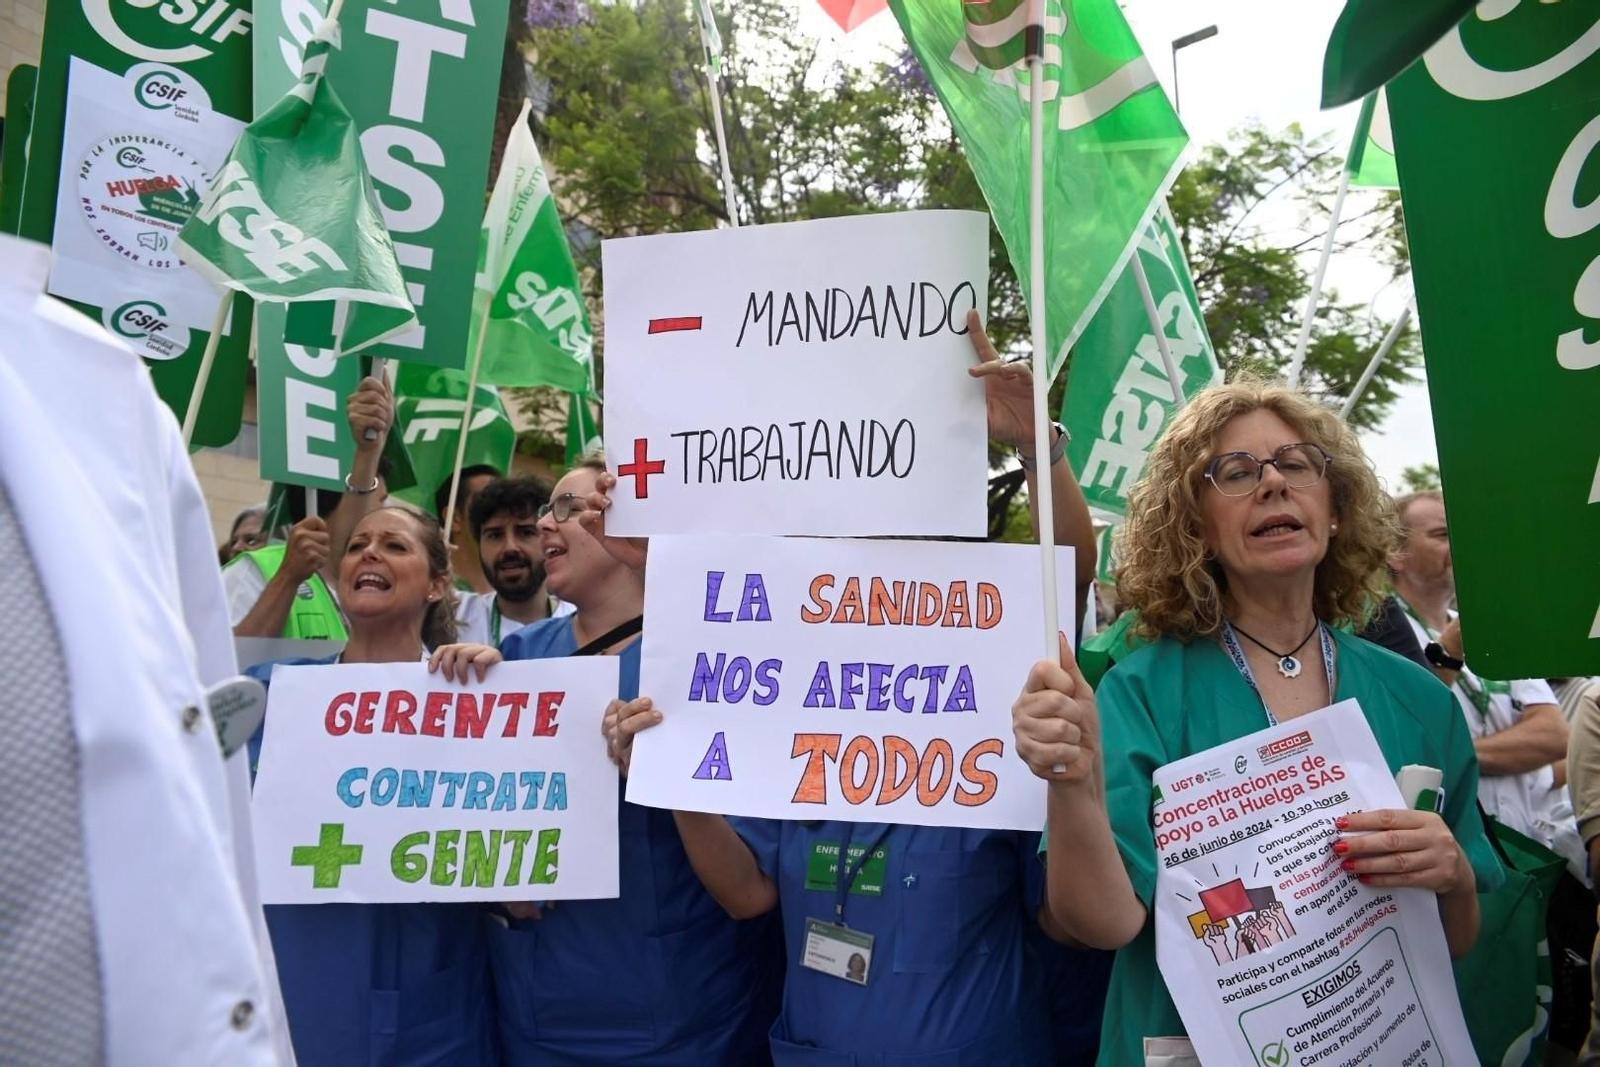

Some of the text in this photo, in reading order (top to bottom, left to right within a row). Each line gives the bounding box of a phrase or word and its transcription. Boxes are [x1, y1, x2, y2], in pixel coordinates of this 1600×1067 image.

[125, 0, 253, 43] SIF
[145, 81, 187, 102] CSIF
[122, 151, 146, 165] CSIF
[106, 174, 182, 198] HUELGA
[123, 309, 170, 333] CSIF
[735, 281, 977, 348] MANDANDO
[670, 418, 916, 484] TRABAJANDO
[702, 570, 1004, 630] LA SANIDAD
[687, 651, 979, 714] NOS AFECTA
[324, 689, 567, 739] GERENTE
[1270, 735, 1302, 753] CCOO
[336, 766, 568, 812] CONTRATA
[691, 731, 1005, 808] A TODOS
[1153, 755, 1326, 829] Concentraciones de
[1170, 776, 1194, 793] UGT
[1206, 814, 1220, 828] a
[1219, 806, 1240, 823] la
[1239, 782, 1306, 815] Huelga
[1306, 764, 1347, 791] SAS
[1163, 852, 1180, 867] 26
[1181, 847, 1199, 860] de
[1199, 835, 1229, 857] junio
[1229, 831, 1245, 845] de
[1245, 818, 1273, 837] 2024
[1281, 803, 1312, 823] 10.30
[1313, 789, 1350, 809] horas
[1257, 818, 1325, 855] Convocamos
[1266, 828, 1341, 866] los trabajado
[389, 828, 562, 888] GENTE
[1273, 869, 1282, 878] a
[1281, 857, 1303, 875] que
[1305, 850, 1318, 863] se
[1279, 880, 1293, 891] en
[1293, 870, 1311, 884] las
[1293, 876, 1329, 901] centros
[1294, 905, 1309, 917] en
[1310, 890, 1336, 912] apoyo
[1335, 884, 1342, 893] a
[1339, 879, 1348, 889] la
[1326, 886, 1359, 917] en el SAS
[1217, 893, 1393, 990] Participa y comparte fotos en tus redes
[1222, 980, 1268, 1005] sociales
[1268, 971, 1290, 988] con
[1290, 963, 1301, 978] el
[1300, 945, 1340, 974] hashtag
[1286, 957, 1396, 1039] Cumplimiento del Acuerdo
[1301, 959, 1363, 1008] EXIGIMOS
[1293, 975, 1396, 1054] de Atención Primaria y de
[1300, 1005, 1383, 1067] Carrera Profesional
[1372, 1039, 1380, 1051] y
[1379, 1012, 1407, 1045] aumento
[1405, 1002, 1417, 1016] de
[1420, 1039, 1432, 1052] de
